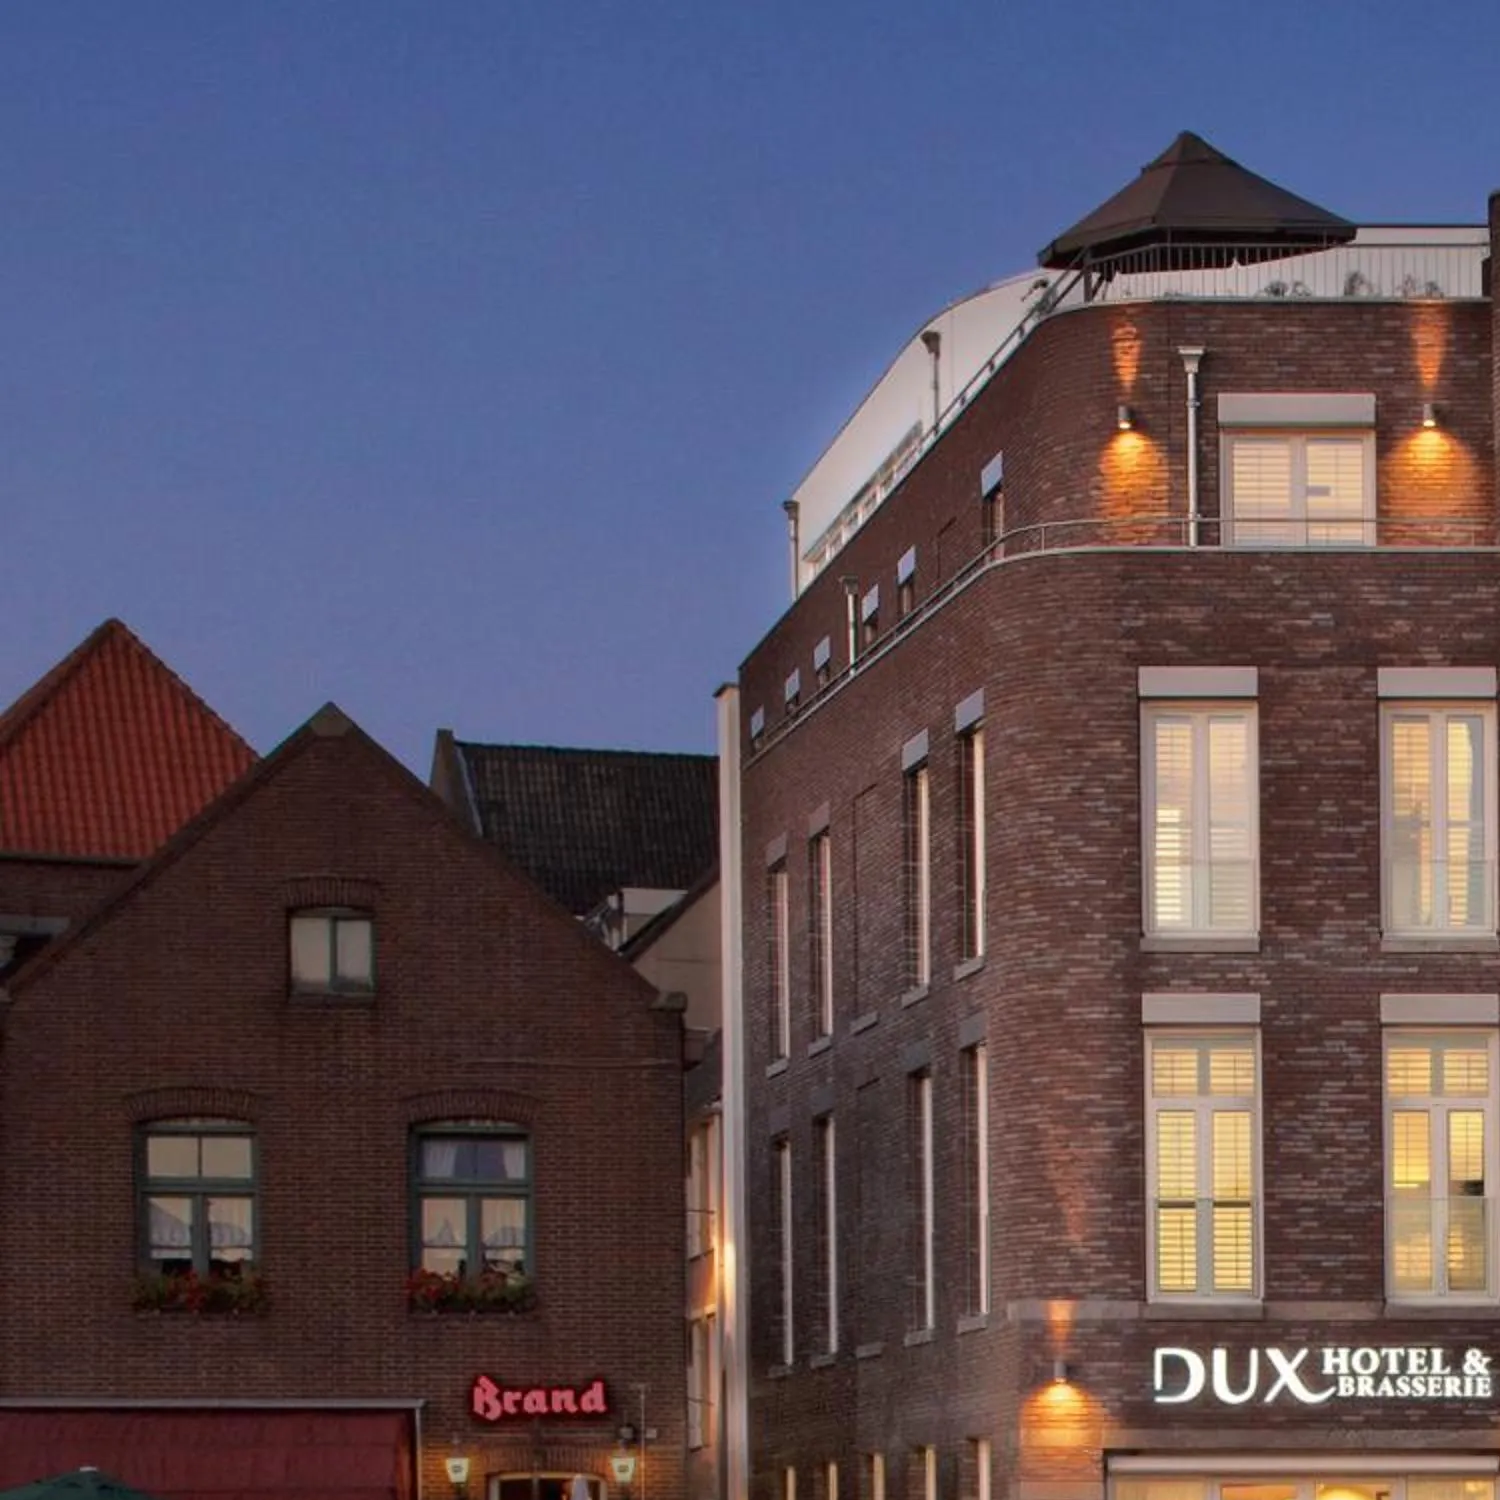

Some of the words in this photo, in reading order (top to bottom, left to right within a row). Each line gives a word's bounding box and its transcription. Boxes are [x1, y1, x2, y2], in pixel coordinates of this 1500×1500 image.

[1153, 1347, 1338, 1405] DUX
[1322, 1348, 1450, 1376] HOTEL
[1464, 1347, 1491, 1376] &
[473, 1376, 607, 1420] Brand
[1336, 1375, 1492, 1398] BRASSERIE
